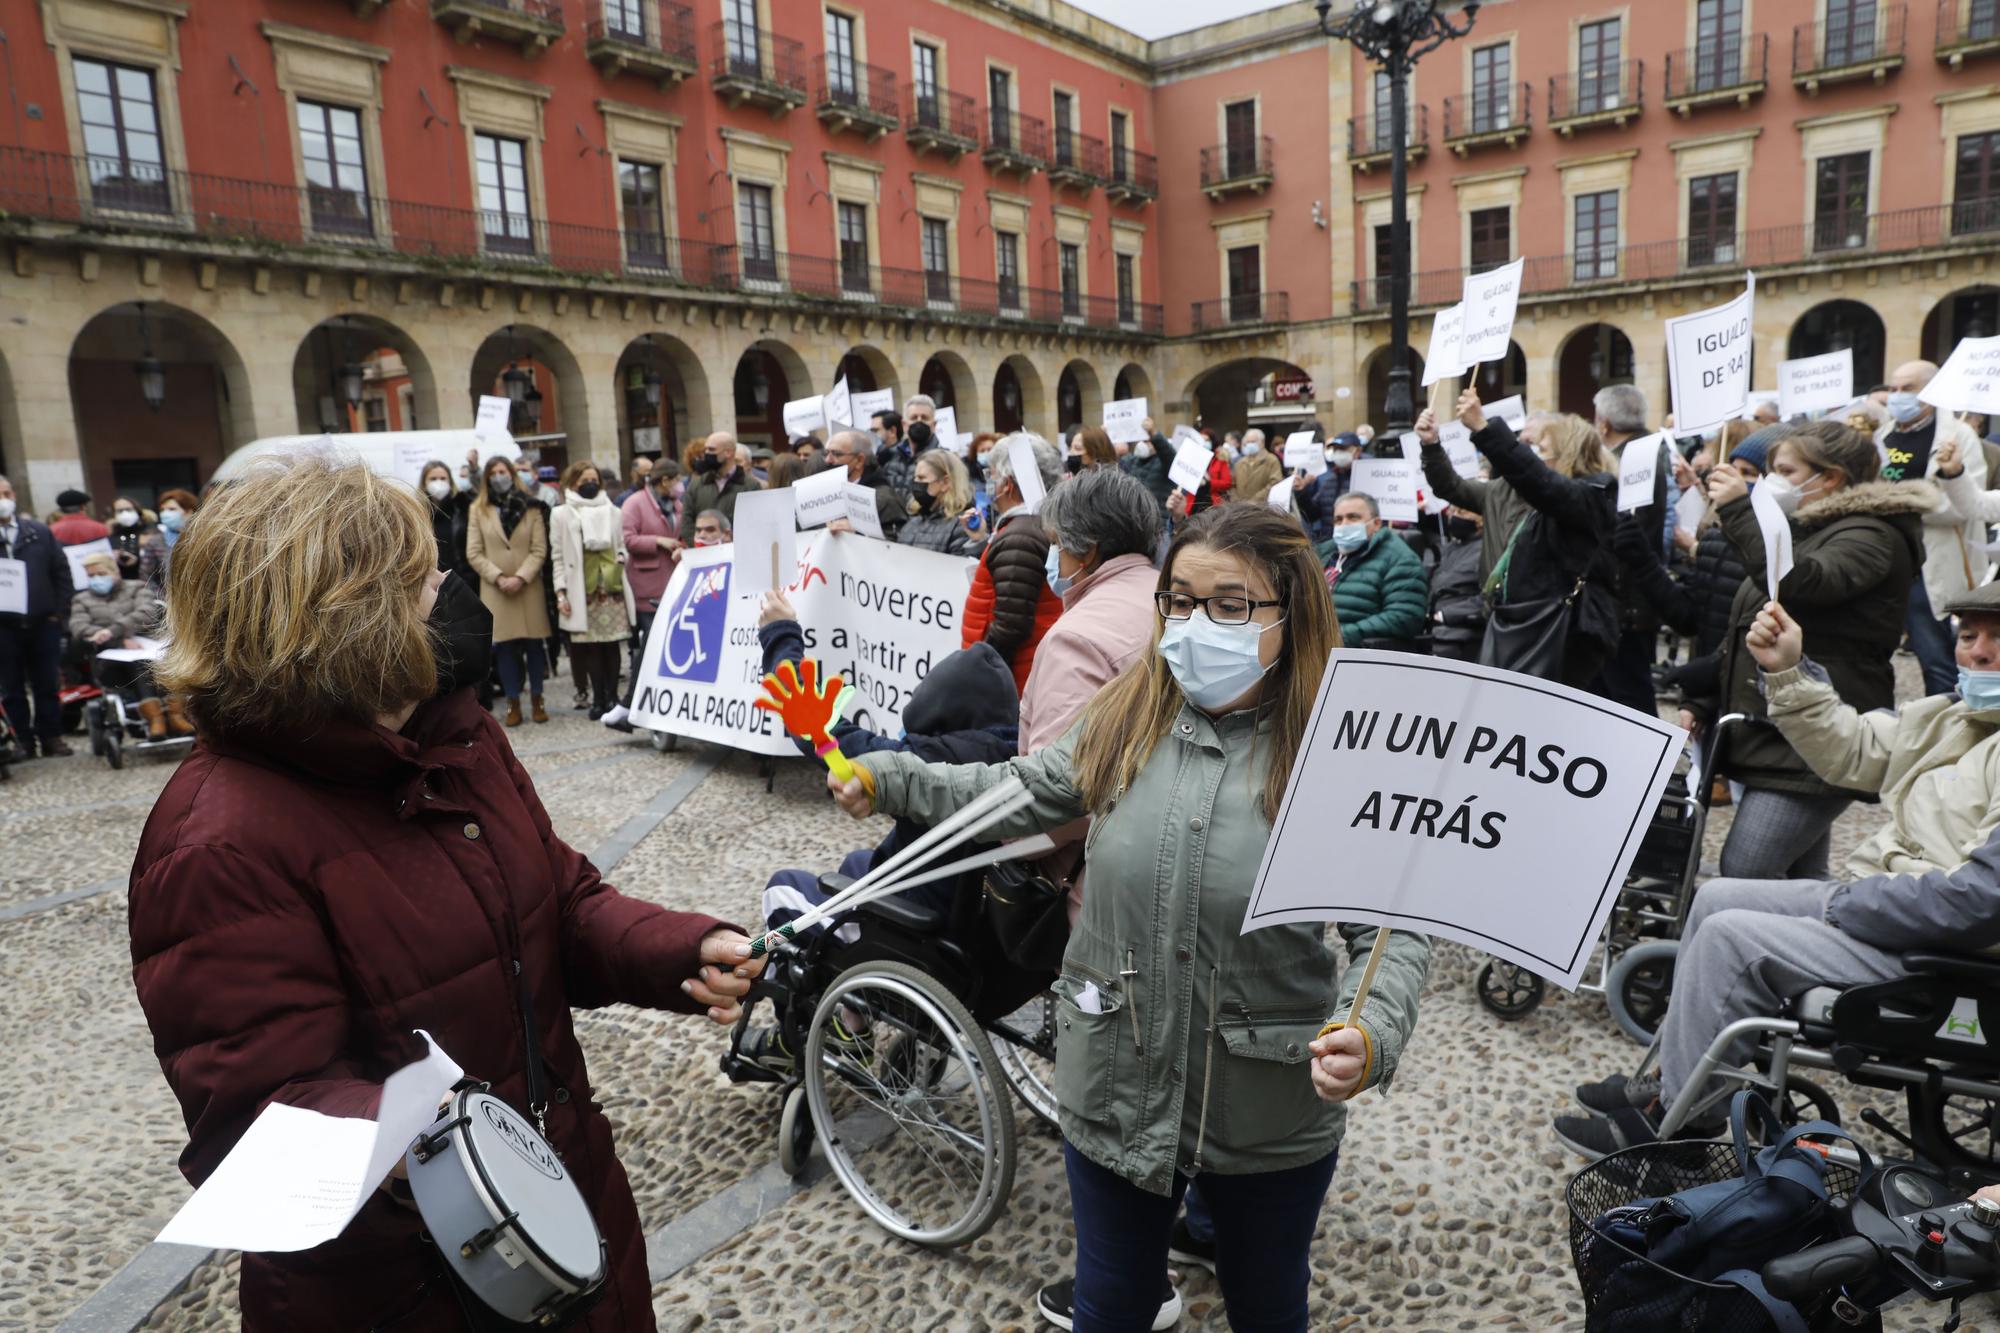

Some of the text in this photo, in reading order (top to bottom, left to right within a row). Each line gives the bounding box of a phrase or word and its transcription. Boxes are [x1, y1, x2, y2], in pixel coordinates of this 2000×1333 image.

[1703, 366, 1725, 388] DE
[841, 568, 954, 630] moverse
[831, 628, 848, 649] a
[638, 686, 673, 716] NO
[677, 692, 700, 721] AL
[704, 695, 747, 730] PAGO
[1333, 710, 1608, 799] NI UN PASO
[1351, 790, 1507, 850] ATRÁS
